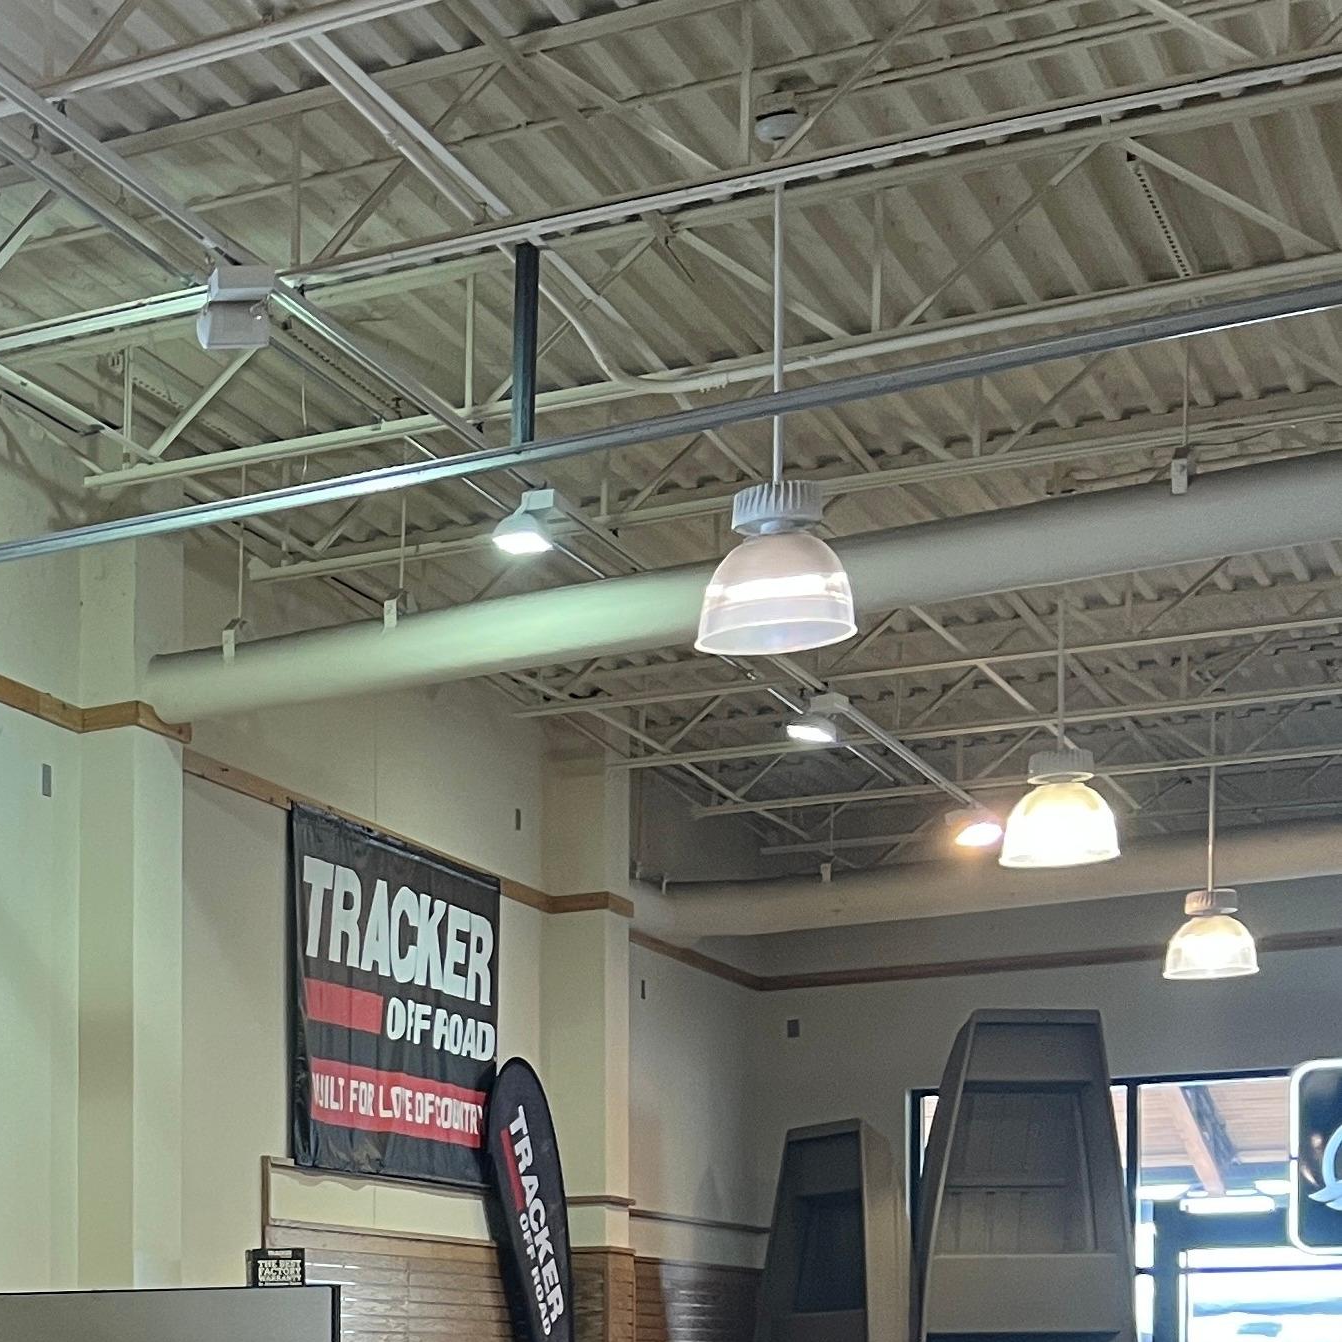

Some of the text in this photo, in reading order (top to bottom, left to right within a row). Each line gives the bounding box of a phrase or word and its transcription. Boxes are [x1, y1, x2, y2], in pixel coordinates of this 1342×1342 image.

[303, 855, 495, 1007] TRACKER
[386, 996, 496, 1062] OFF ROAD
[349, 1079, 375, 1117] FOR
[414, 1091, 435, 1125] OF
[509, 1104, 564, 1324] TRACKER
[519, 1212, 553, 1336] OFF ROAD
